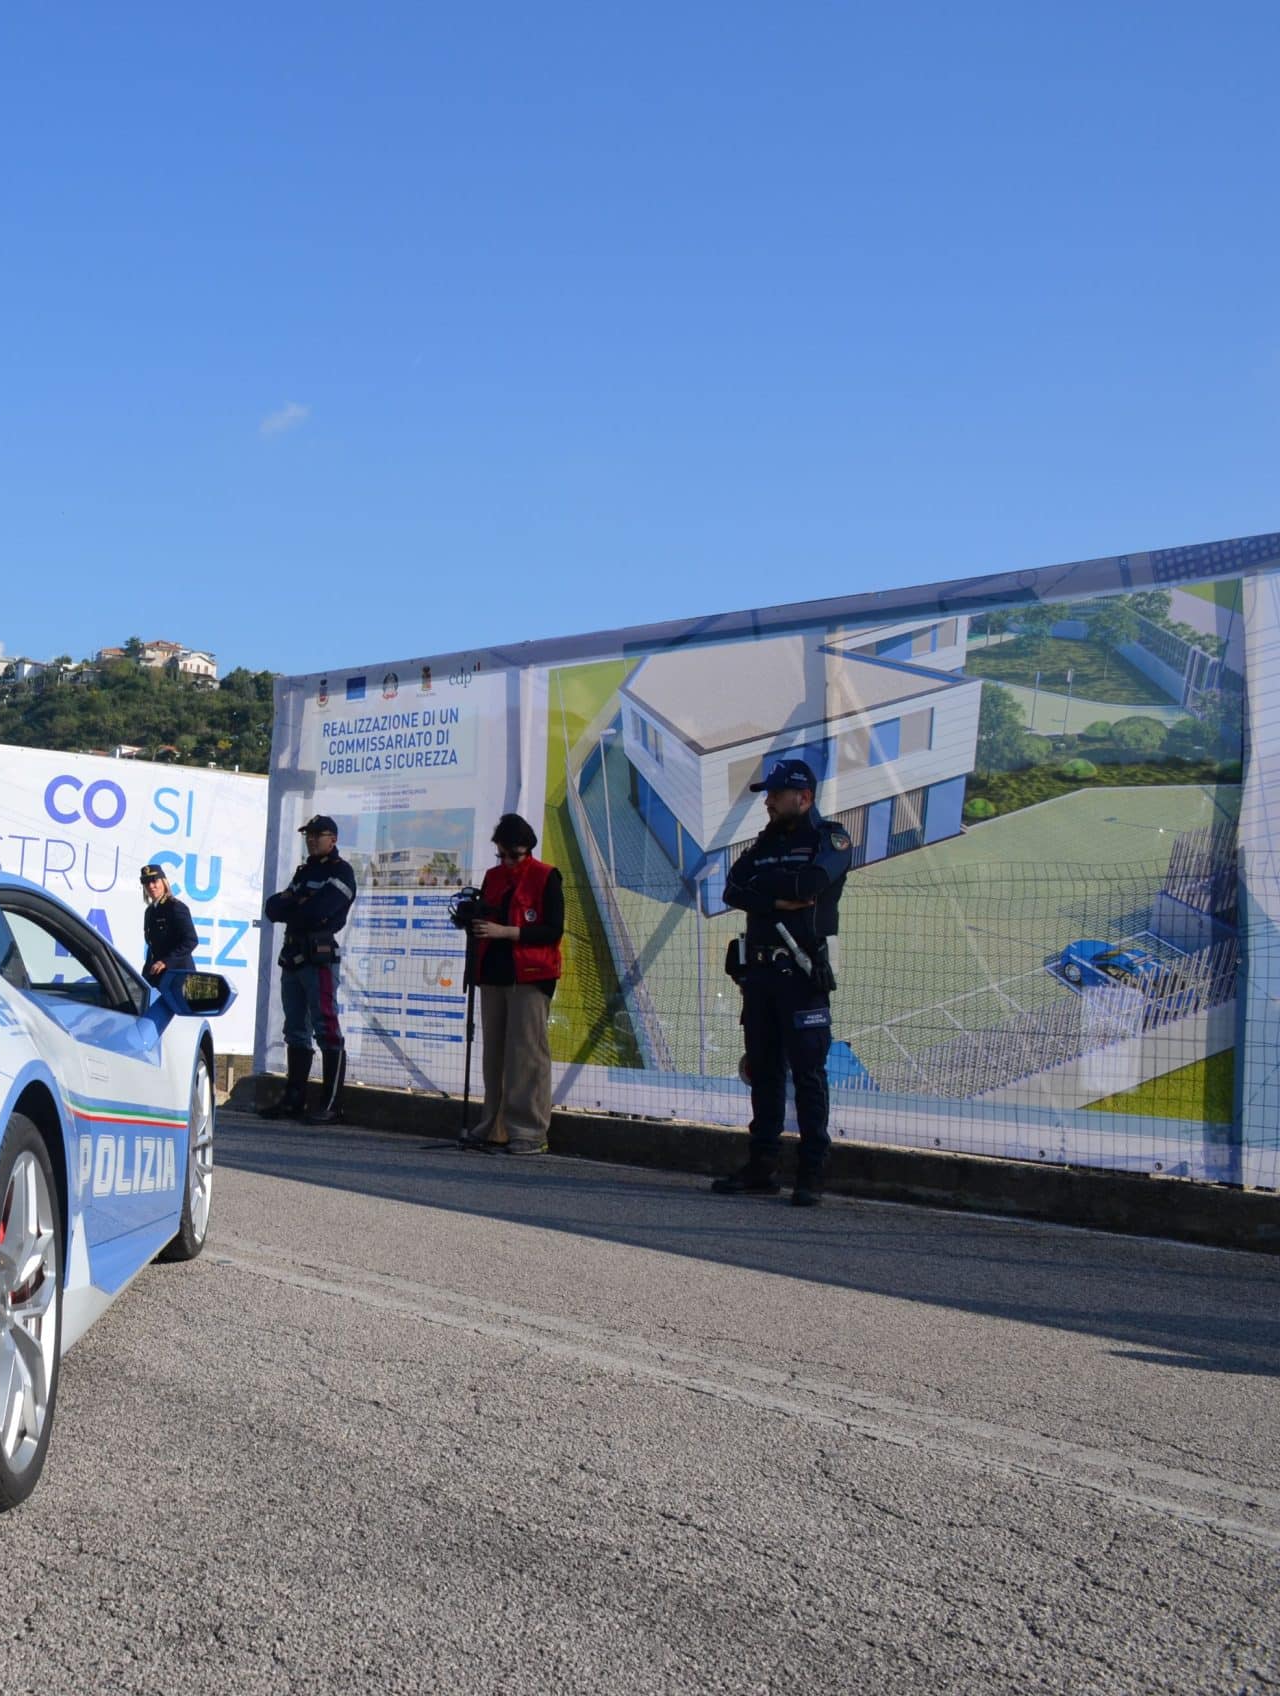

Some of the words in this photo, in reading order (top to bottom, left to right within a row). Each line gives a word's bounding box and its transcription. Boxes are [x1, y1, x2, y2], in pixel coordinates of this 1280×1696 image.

[322, 712, 419, 737] REALIZZAZIONE
[423, 710, 436, 726] DI
[440, 707, 459, 724] UN
[328, 731, 433, 756] COMMISSARIATO
[436, 729, 450, 746] DI
[320, 756, 382, 776] PUBBLICA
[385, 749, 458, 770] SICUREZZA
[44, 774, 127, 829] CO
[150, 787, 194, 838] SI
[144, 917, 250, 968] EZ
[77, 1134, 176, 1198] POLIZIA
